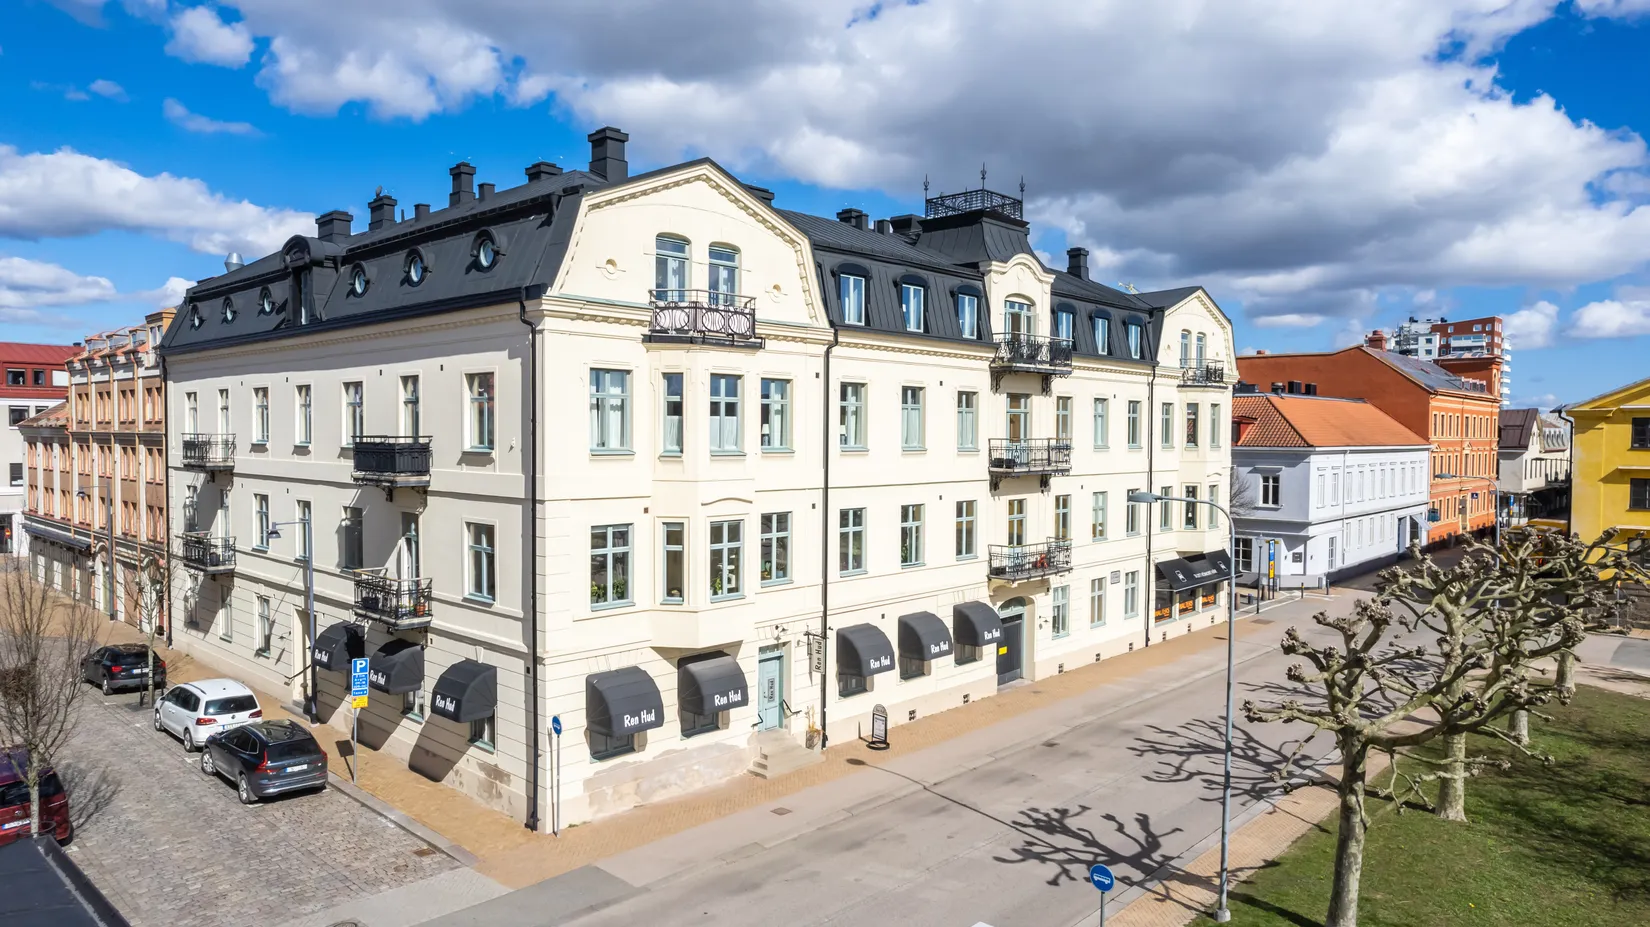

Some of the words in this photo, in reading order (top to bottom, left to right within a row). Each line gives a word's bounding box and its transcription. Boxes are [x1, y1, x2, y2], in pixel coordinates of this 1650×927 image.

[984, 630, 992, 640] Ren
[992, 628, 1001, 637] Hud
[314, 648, 322, 660] Ren
[814, 641, 823, 655] Hud
[931, 643, 940, 655] Ren
[940, 640, 949, 651] Hud
[356, 660, 366, 672] P
[814, 658, 823, 671] Ren
[870, 659, 880, 670] Ren
[881, 655, 891, 666] Hud
[369, 669, 378, 682] Ren
[378, 672, 387, 686] Hud
[436, 696, 445, 709] Ren
[445, 699, 456, 713] Hud
[715, 694, 727, 707] Ren
[728, 689, 741, 703] Hud
[624, 714, 639, 727] Ren
[641, 708, 656, 723] Hud
